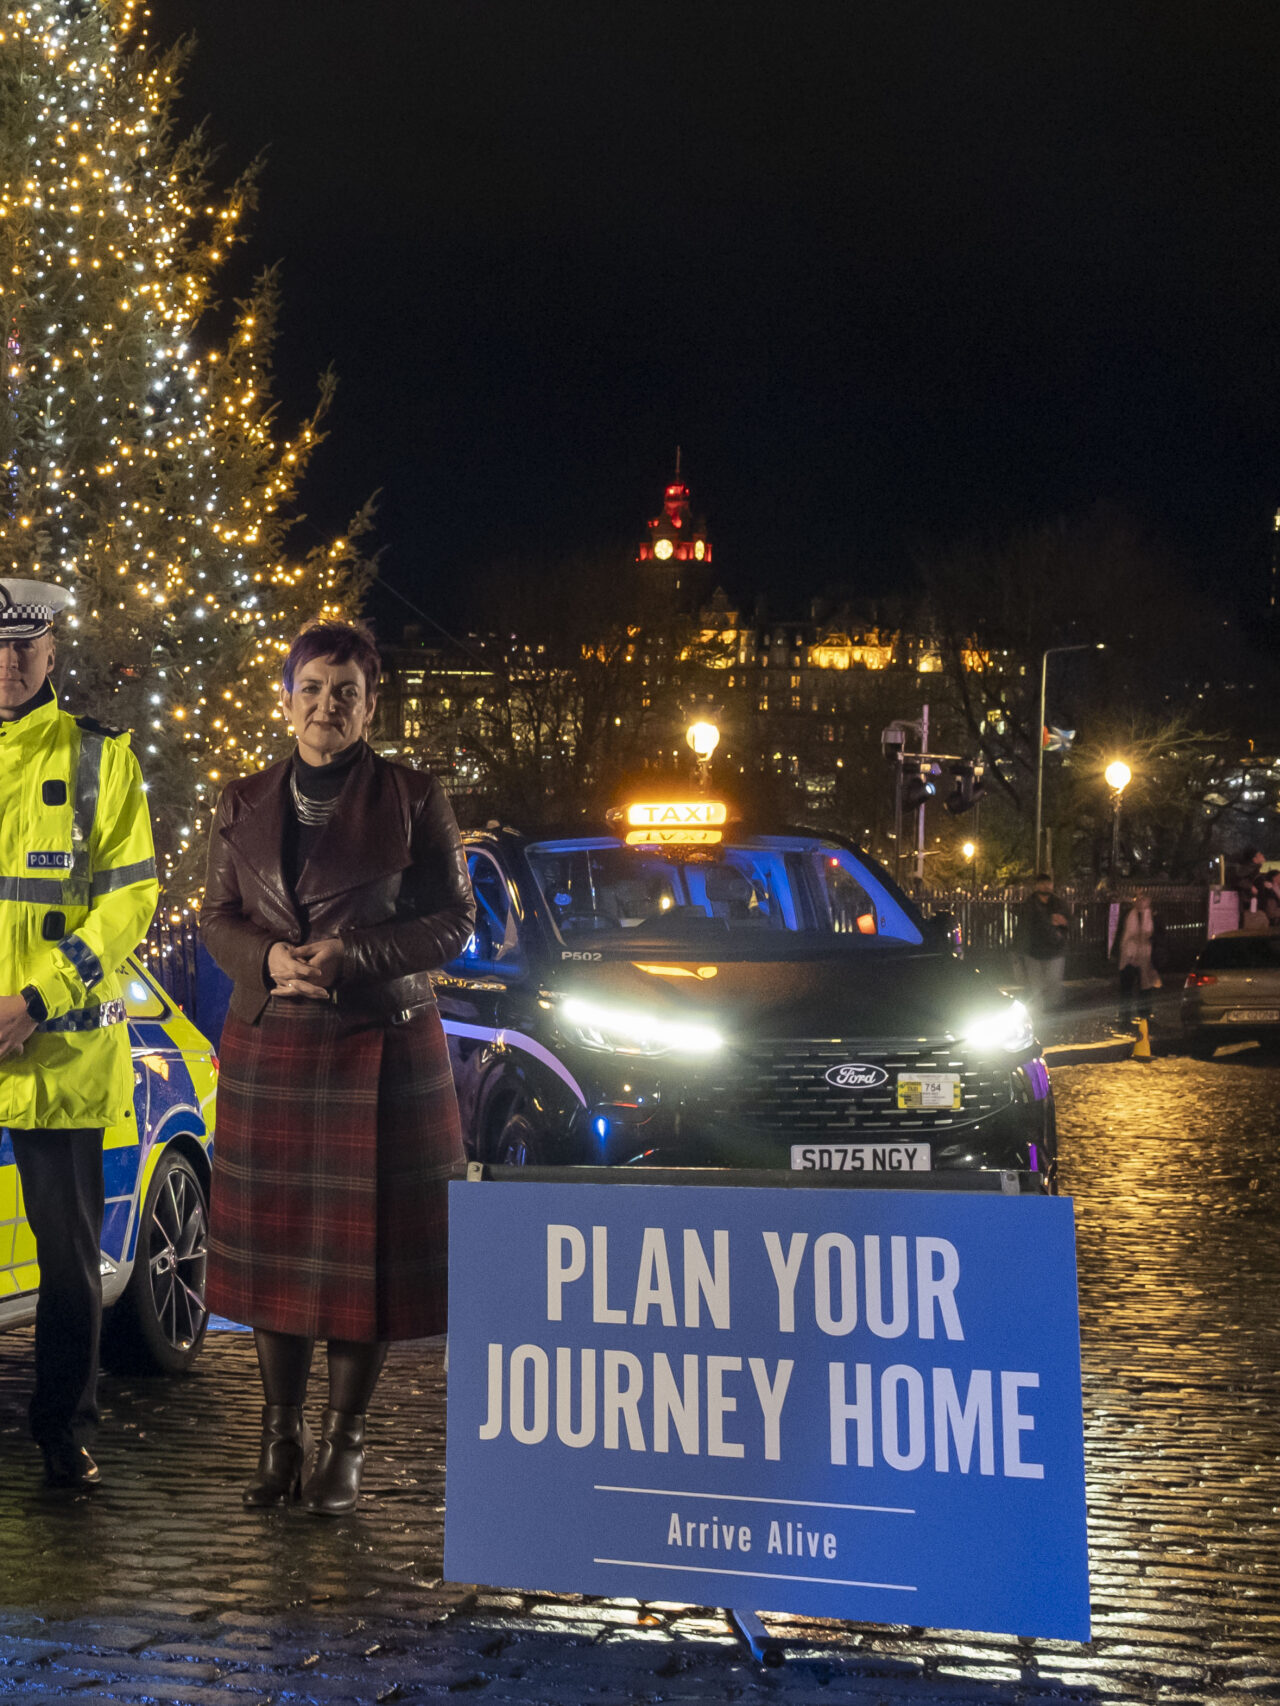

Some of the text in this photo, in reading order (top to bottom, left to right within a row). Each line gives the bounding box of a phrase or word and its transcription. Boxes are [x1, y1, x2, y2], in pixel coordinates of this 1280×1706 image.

[643, 806, 711, 822] TAXI
[561, 951, 603, 961] P502
[836, 1066, 877, 1085] Ford
[802, 1147, 918, 1171] SD75 NGY
[546, 1224, 965, 1341] PLAN YOUR
[479, 1343, 1045, 1479] JOURNEY HOME
[667, 1512, 837, 1560] Arrive Alive
